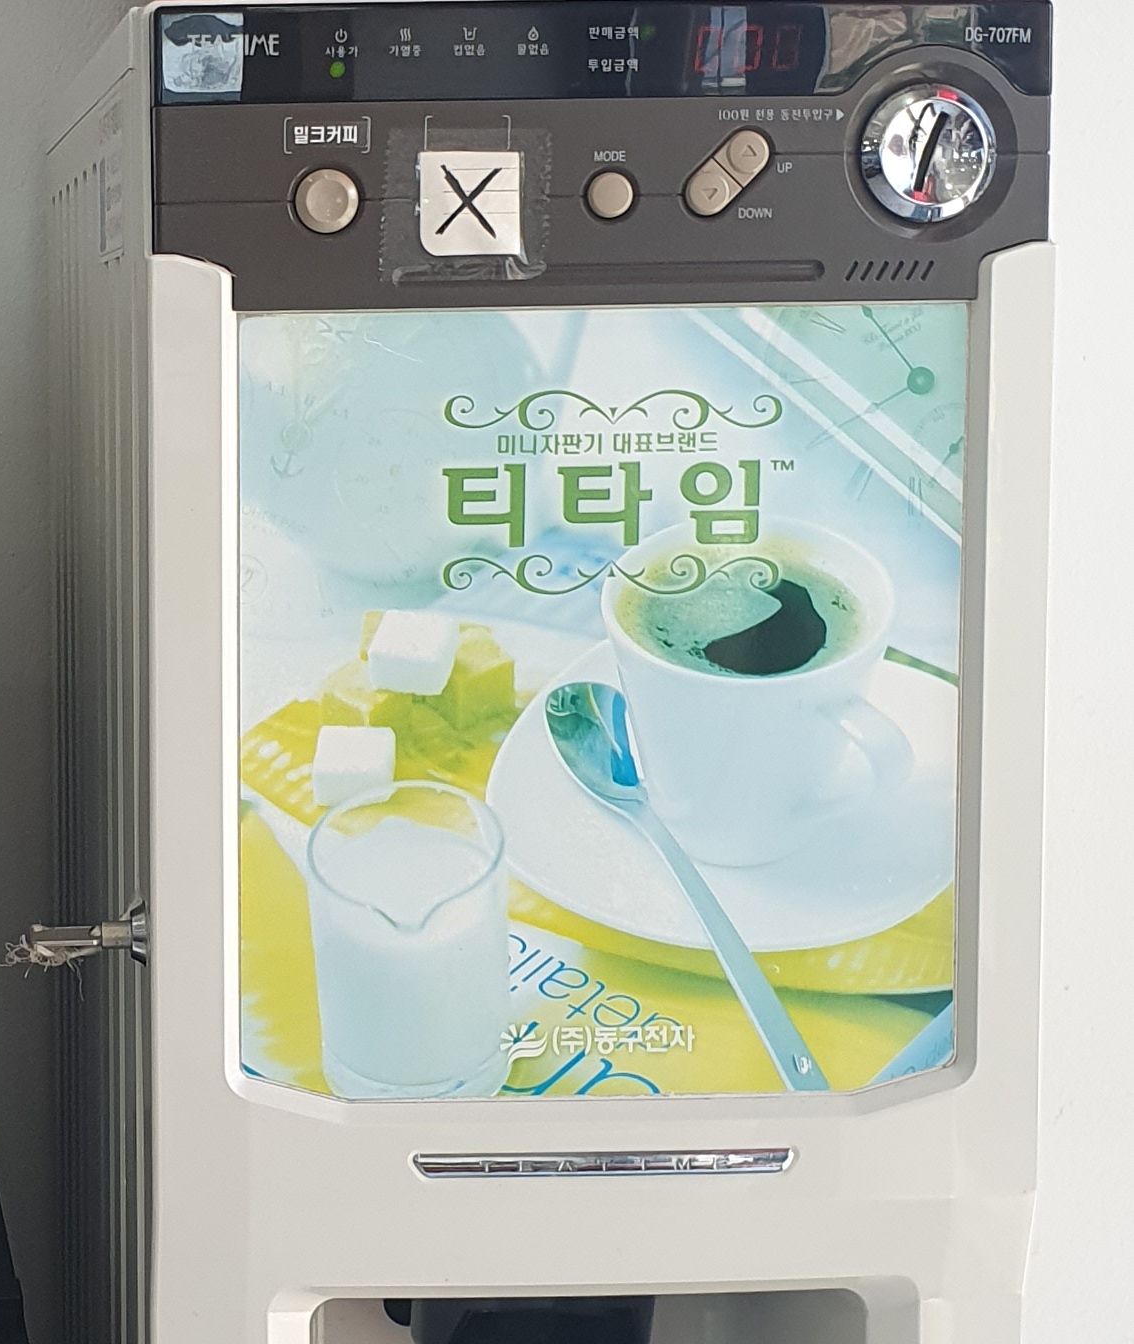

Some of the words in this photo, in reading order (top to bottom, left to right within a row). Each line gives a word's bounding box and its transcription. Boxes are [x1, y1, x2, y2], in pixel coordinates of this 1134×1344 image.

[588, 26, 639, 40] 판매금액
[965, 27, 1031, 43] DG-707FM
[588, 58, 639, 72] 투입금액
[294, 125, 358, 145] 밀크커피
[594, 150, 626, 162] MODE
[777, 162, 793, 173] UP
[738, 208, 772, 219] DOWN
[497, 433, 604, 455] 미니자판기
[613, 432, 718, 453] 대표브랜드
[442, 459, 761, 548] 티타임
[552, 1024, 695, 1055] (주)동구전자
